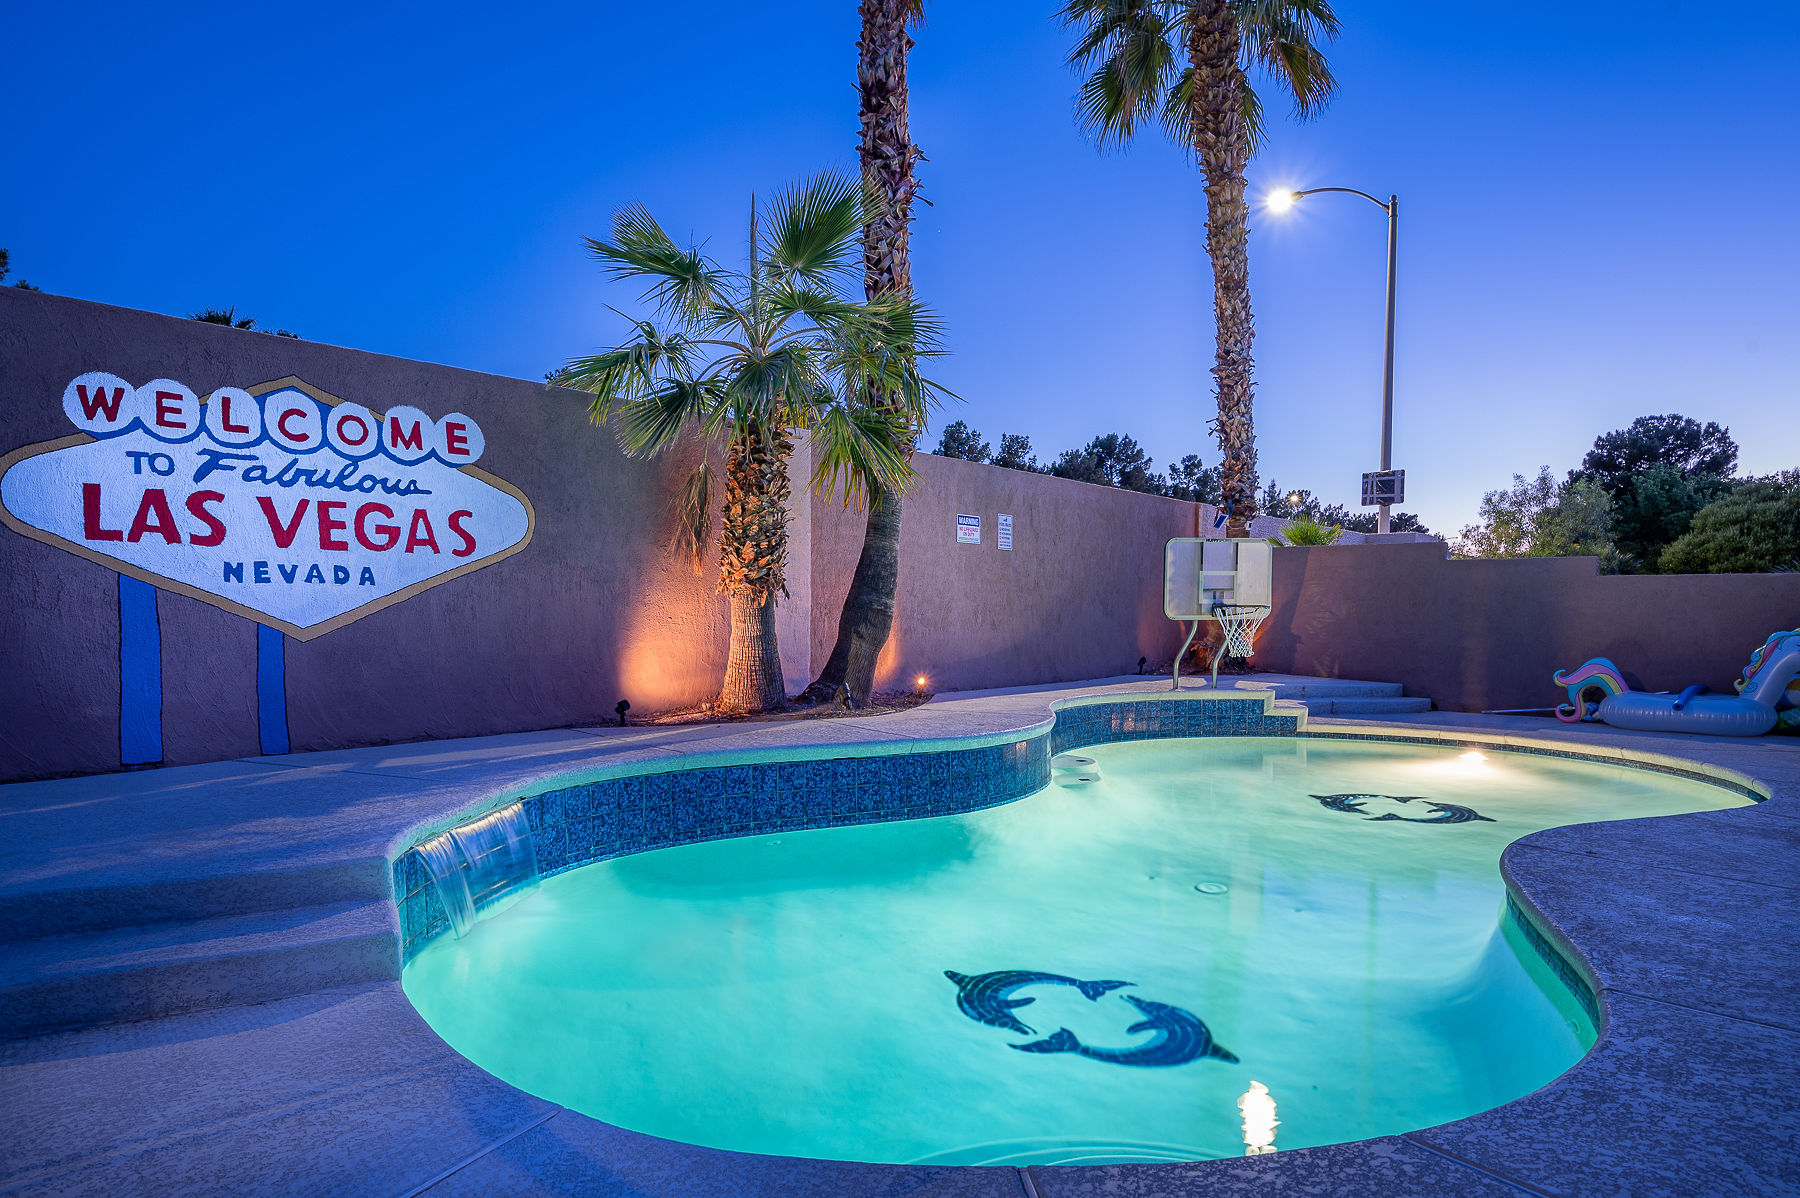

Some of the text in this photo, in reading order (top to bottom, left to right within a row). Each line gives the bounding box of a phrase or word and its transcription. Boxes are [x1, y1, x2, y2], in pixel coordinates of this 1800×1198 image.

[76, 384, 471, 456] WELCOME
[126, 448, 432, 495] TO Fabulous
[82, 483, 477, 557] LAS VEGAS
[958, 516, 979, 526] WARNING
[223, 561, 377, 587] NEVADA
